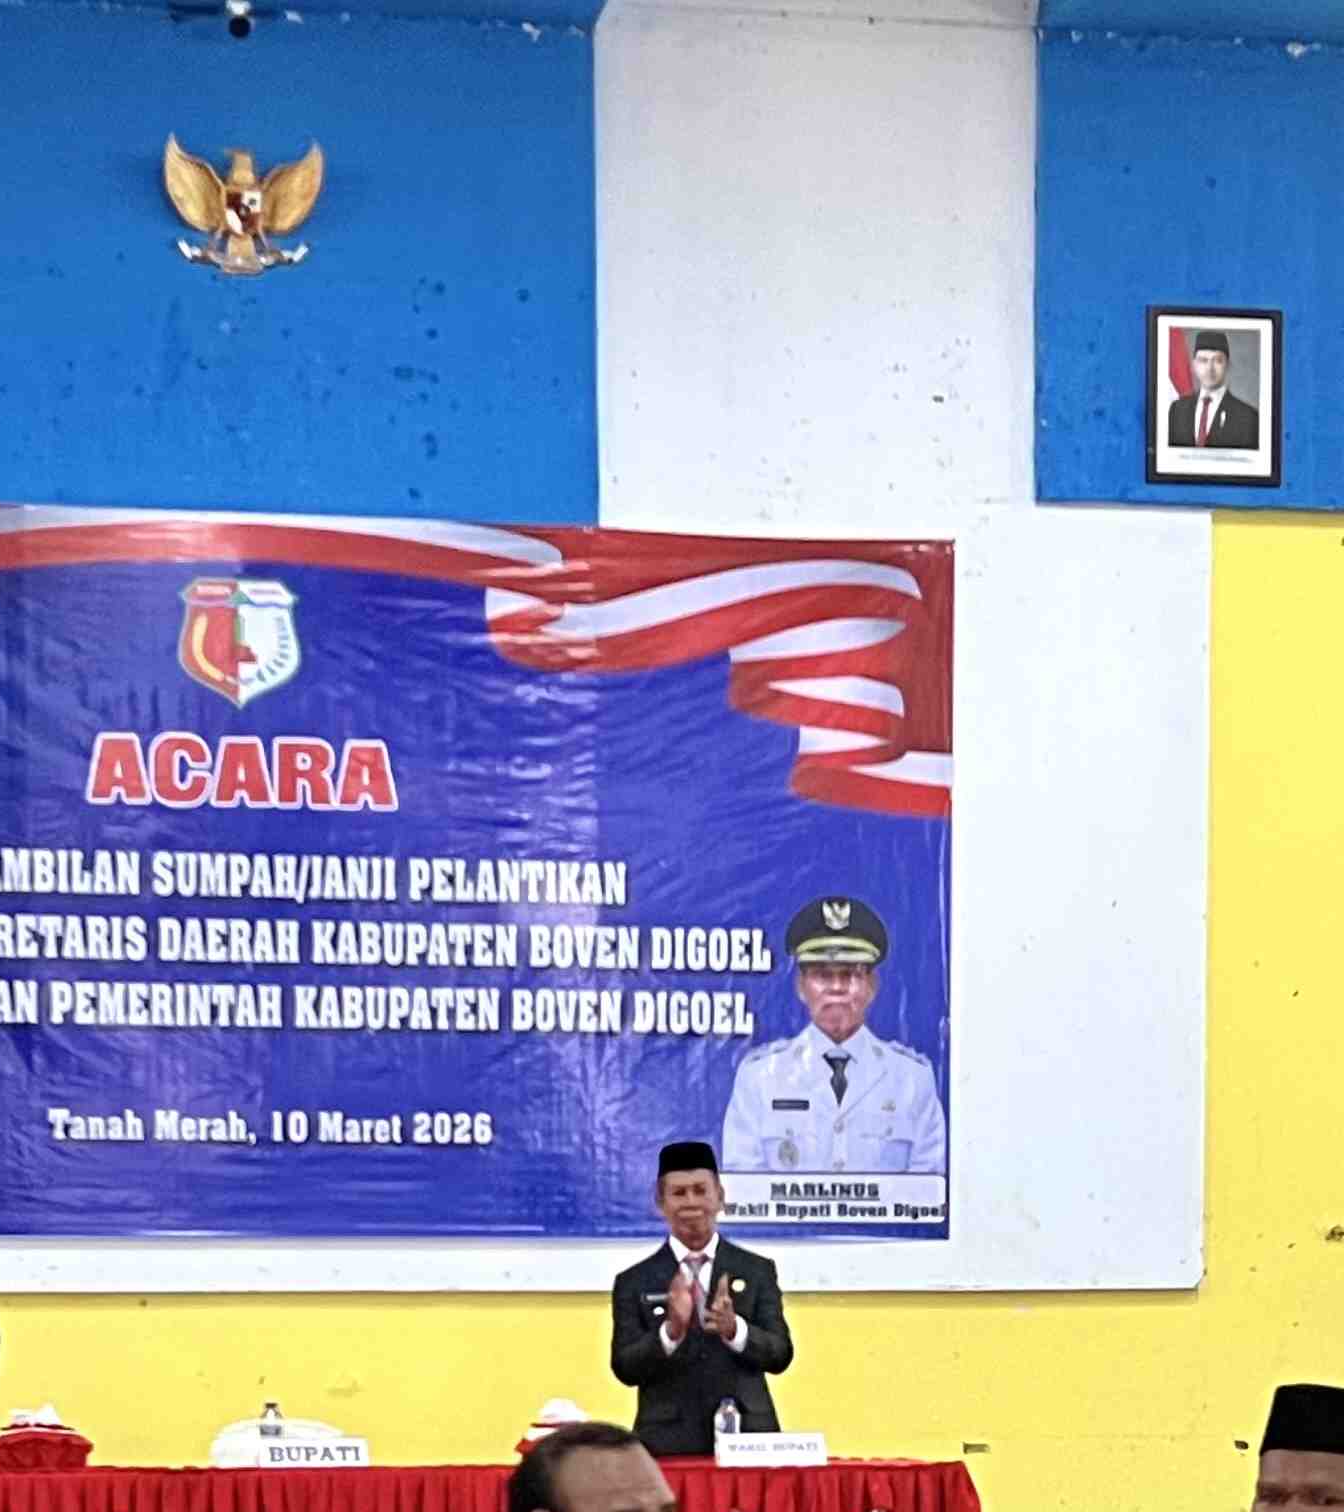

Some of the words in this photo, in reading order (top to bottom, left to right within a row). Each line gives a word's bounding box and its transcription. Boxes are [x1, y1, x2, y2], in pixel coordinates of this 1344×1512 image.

[87, 731, 399, 812] ACARA
[152, 851, 396, 903] SUMPAH/JANJI
[409, 858, 627, 905] PELANTIKAN
[158, 917, 299, 964] DAERAH
[312, 920, 517, 967] KABUPATEN
[529, 924, 639, 969] BOVEN
[651, 927, 771, 972] DIGOEL
[49, 981, 282, 1028] PEMERINTAH
[294, 984, 499, 1031] KABUPATEN
[512, 988, 622, 1033] BOVEN
[634, 990, 753, 1035] DIGOEL
[48, 1107, 144, 1141] Tanah
[154, 1108, 256, 1144] Merah,
[271, 1110, 308, 1143] 10
[318, 1110, 403, 1144] Maret
[413, 1112, 492, 1144] 2026
[770, 1183, 880, 1198] MARLINUS
[776, 1203, 831, 1219] Bupati
[838, 1204, 887, 1217] Boven
[894, 1204, 946, 1219] Digoel
[268, 1446, 360, 1462] BUPATI
